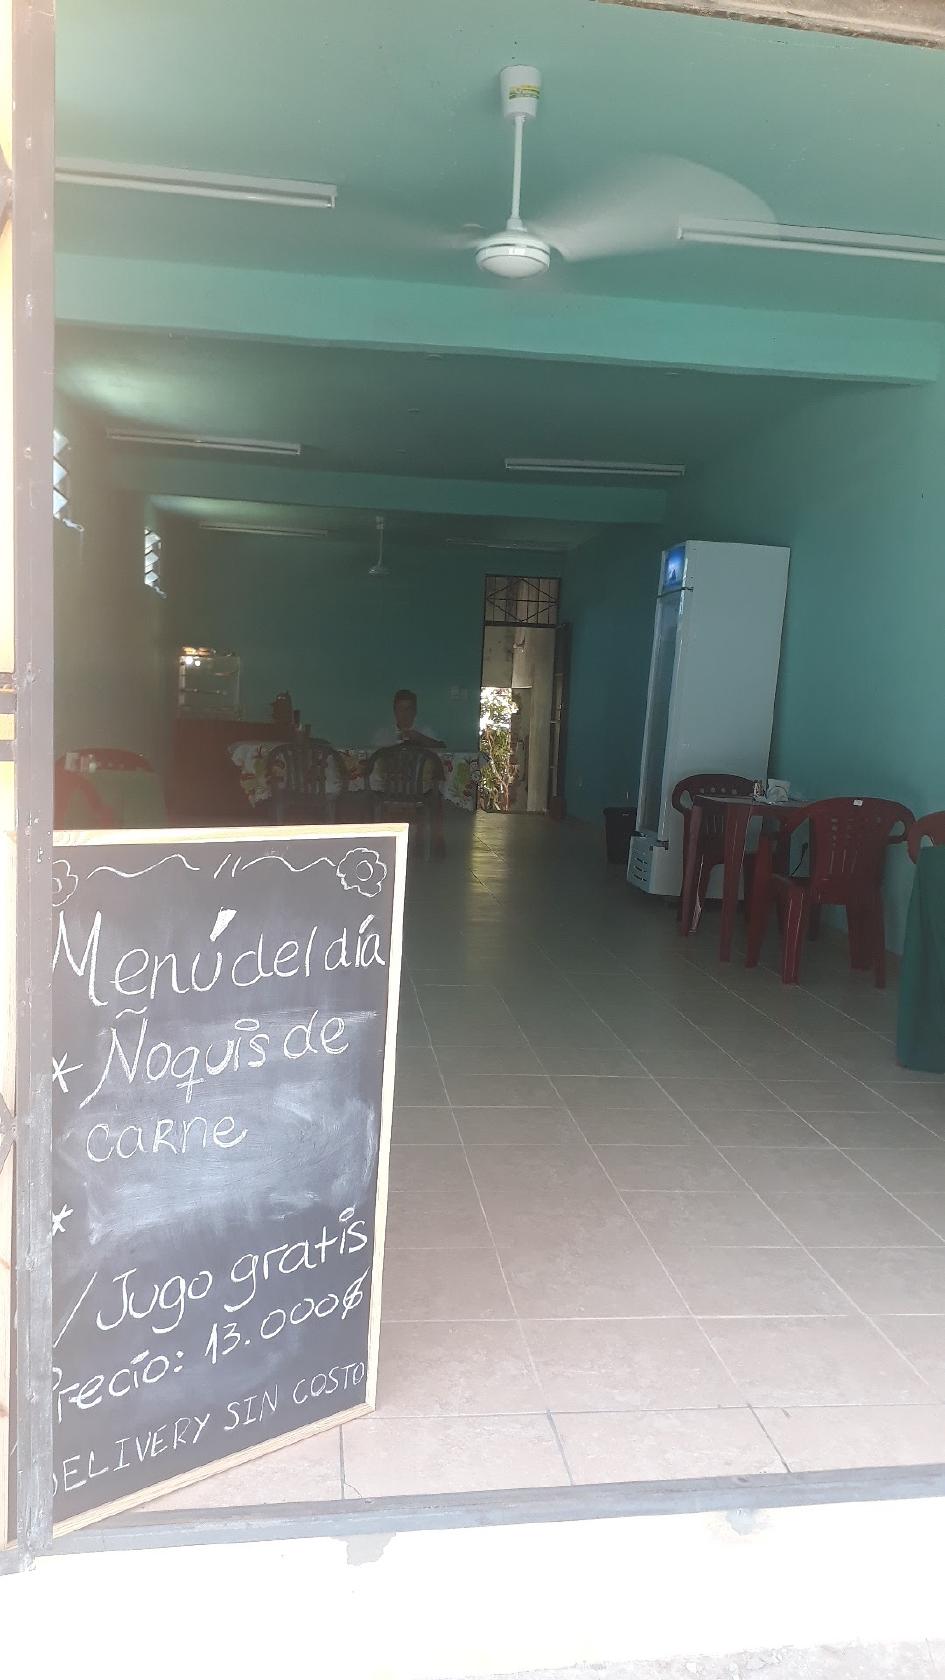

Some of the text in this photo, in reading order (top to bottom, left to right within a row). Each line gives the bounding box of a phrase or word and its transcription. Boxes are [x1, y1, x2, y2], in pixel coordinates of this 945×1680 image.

[52, 907, 385, 1006] Menú del día
[79, 1006, 349, 1108] Ñoquis de
[223, 1207, 368, 1312] gratis
[53, 1362, 365, 1496] ELIVERY SIN COSTO
